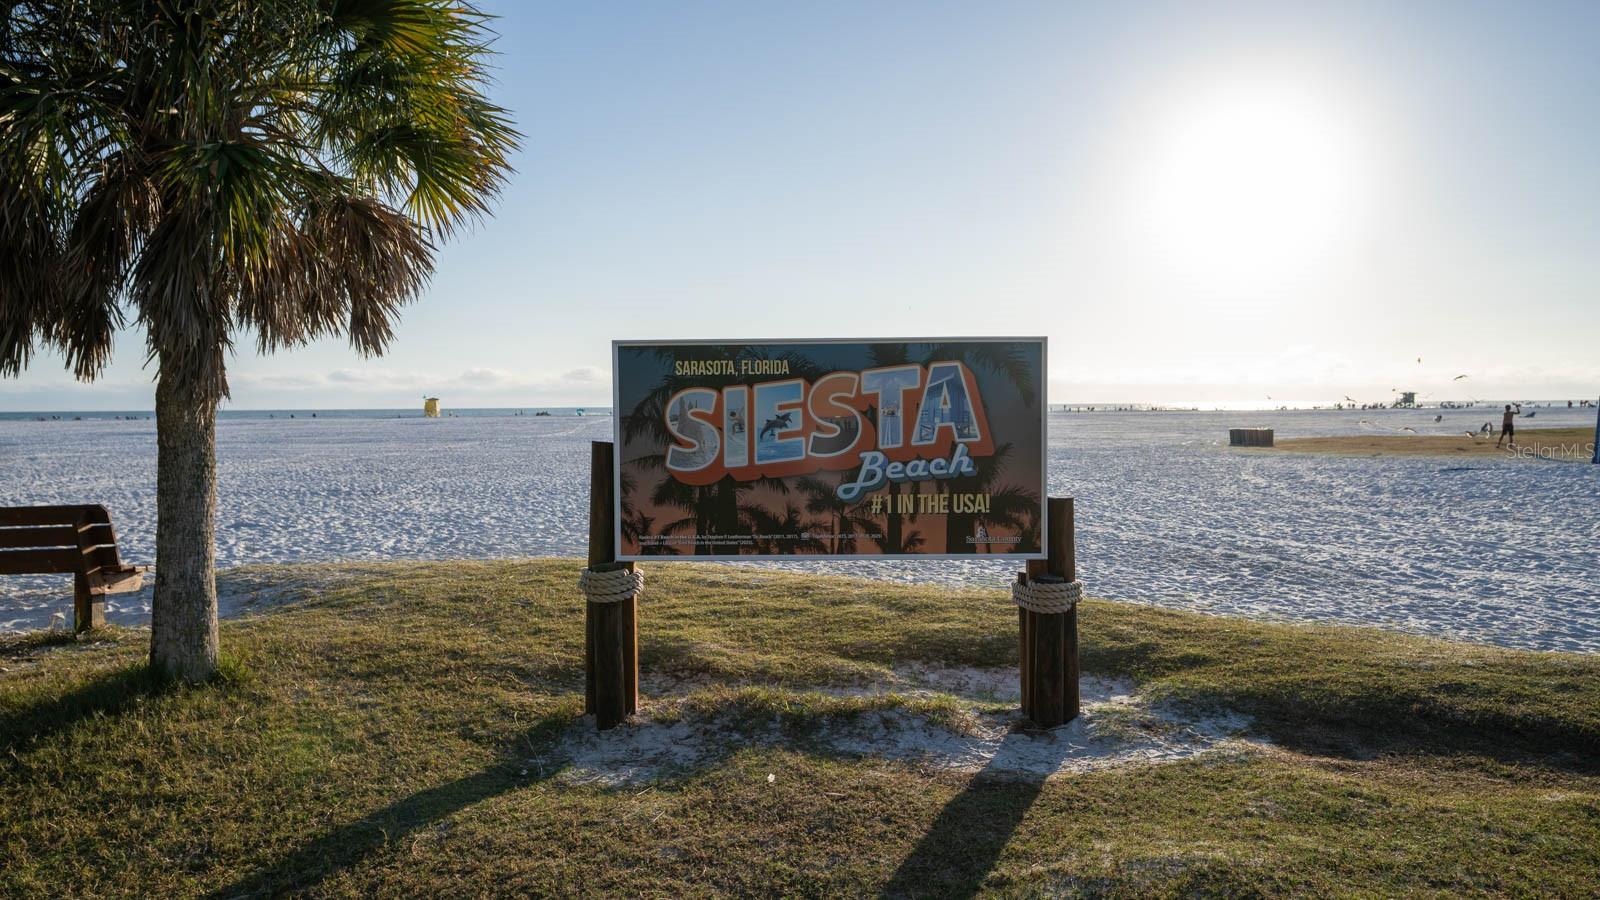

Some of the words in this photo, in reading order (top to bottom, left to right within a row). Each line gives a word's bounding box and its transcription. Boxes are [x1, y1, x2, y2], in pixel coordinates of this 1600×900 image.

[675, 360, 738, 377] SARASOTA,
[741, 359, 790, 375] FLORIDA
[664, 361, 984, 474] SIESTA
[836, 443, 975, 500] Beach
[897, 494, 914, 514] IN
[917, 493, 949, 514] THE
[952, 492, 991, 513] USA!
